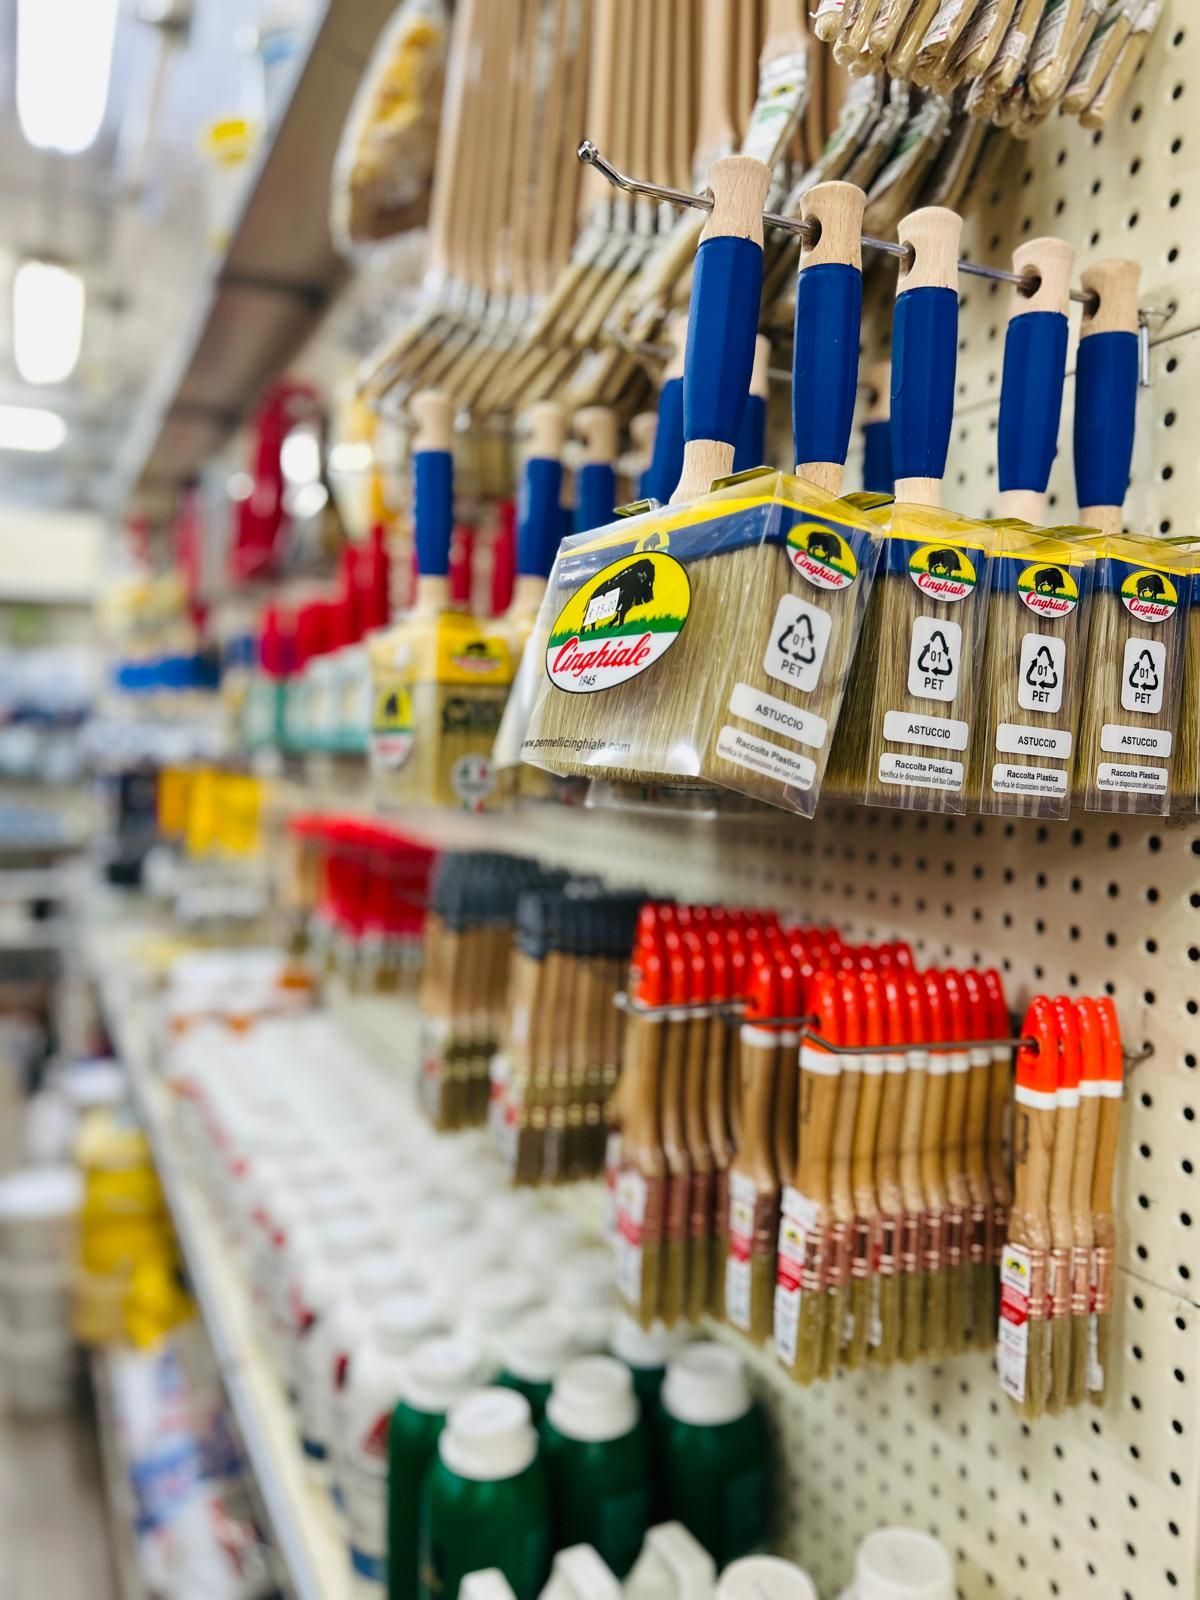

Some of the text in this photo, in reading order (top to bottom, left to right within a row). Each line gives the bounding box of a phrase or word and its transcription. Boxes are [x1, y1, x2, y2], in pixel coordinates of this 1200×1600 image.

[793, 550, 844, 587] Cinghiale
[918, 571, 966, 597] Cinghiale
[1025, 591, 1070, 612] Cinghiale
[1128, 597, 1170, 617] Cinghiale
[792, 633, 806, 649] 01
[552, 632, 652, 678] Cinghiale
[930, 650, 942, 663] 01
[780, 658, 804, 678] PET
[1037, 664, 1048, 677] 01
[1139, 667, 1149, 679] 01
[579, 674, 597, 687] 1945
[924, 677, 944, 691] PET
[1032, 690, 1050, 703] PET
[1134, 692, 1151, 705] PET
[755, 703, 804, 731] ASTUCCIO
[907, 724, 951, 739] ASTUCCIO
[1017, 735, 1057, 749] ASTUCCIO
[1121, 735, 1158, 748] ASTUCCIO
[735, 735, 801, 770] Raccolta Plastica
[895, 759, 953, 775] Raccolta Plastica
[1110, 768, 1160, 780] Raccolta Plastica
[880, 769, 899, 780] Verifica
[904, 773, 932, 783] disposizioni
[1006, 769, 1059, 782] Raccolta Plastica
